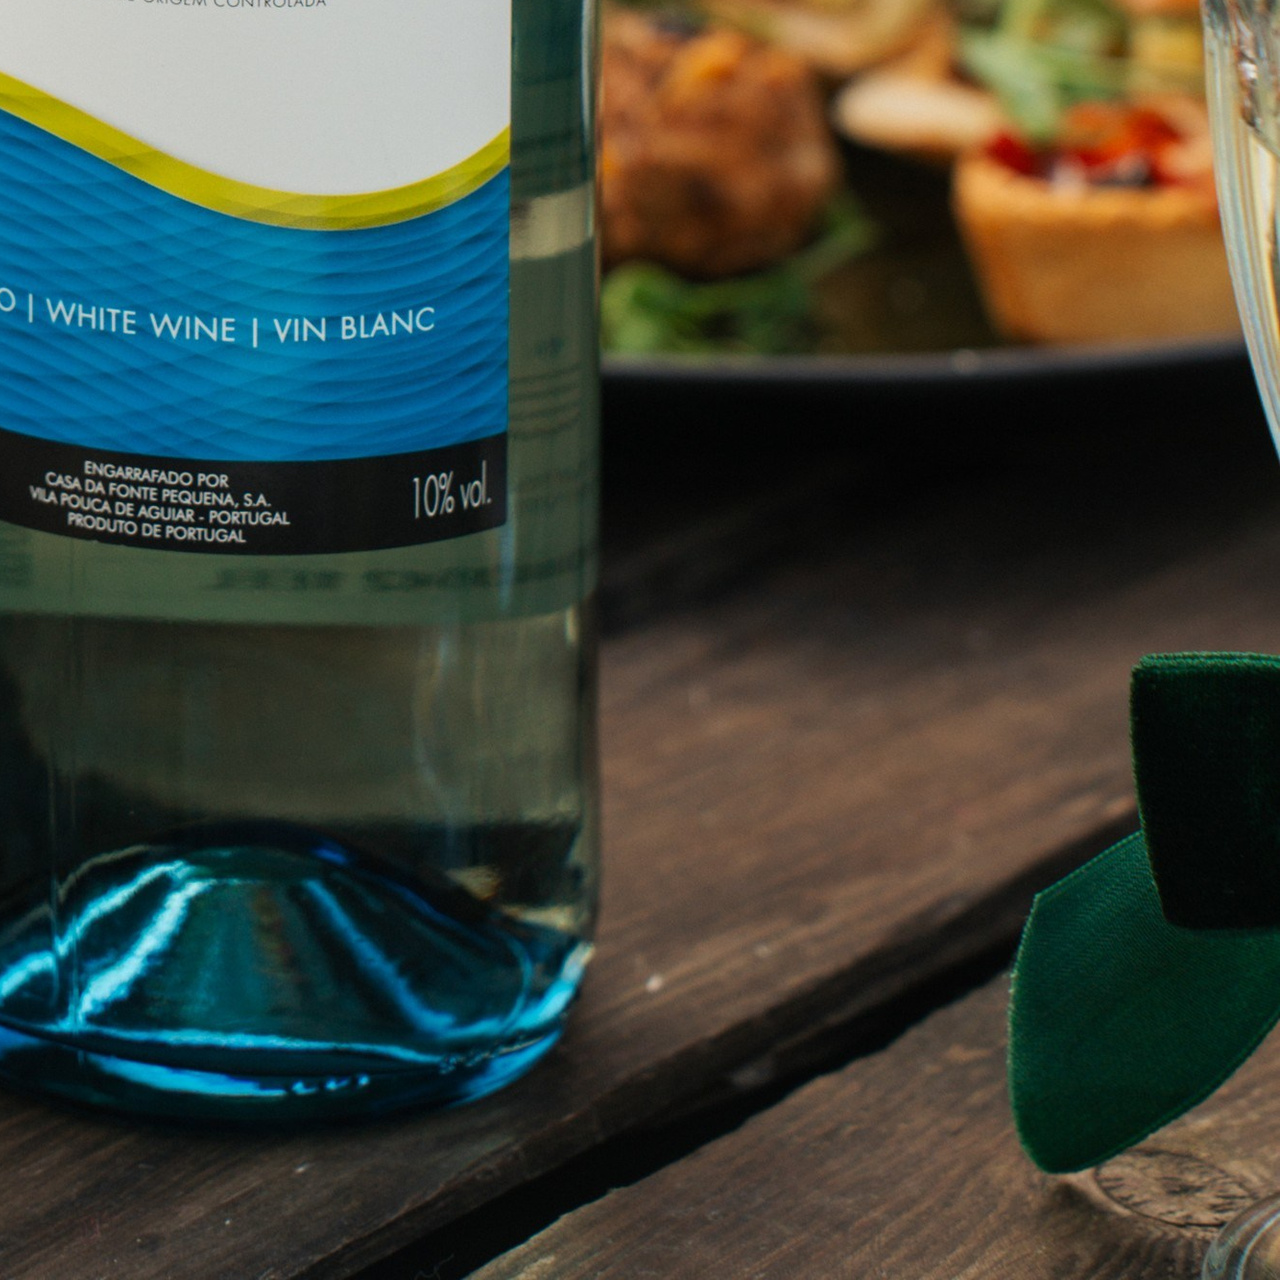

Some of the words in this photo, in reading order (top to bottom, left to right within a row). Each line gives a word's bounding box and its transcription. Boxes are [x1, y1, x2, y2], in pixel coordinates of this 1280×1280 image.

[46, 298, 136, 335] WHITE
[149, 313, 236, 342] WINE
[273, 317, 326, 343] VIN
[341, 307, 435, 340] BLANC
[45, 472, 82, 491] CASA
[84, 480, 106, 495] DA
[109, 483, 158, 501] FONTE
[162, 489, 239, 508] PEQUENA,
[243, 493, 271, 507] S.A.
[84, 460, 193, 486] ENGARRAFADO
[197, 474, 229, 488] POR
[412, 470, 455, 519] 10%
[460, 460, 492, 510] vol.
[29, 485, 58, 504] VILA
[61, 494, 112, 514] POUCA
[115, 502, 134, 517] DE
[137, 506, 195, 523] AGUIAR
[209, 511, 291, 525] PORTUGAL
[67, 512, 137, 535] PRODUTO
[141, 523, 162, 537] DE
[166, 526, 247, 543] PORTUGAL
